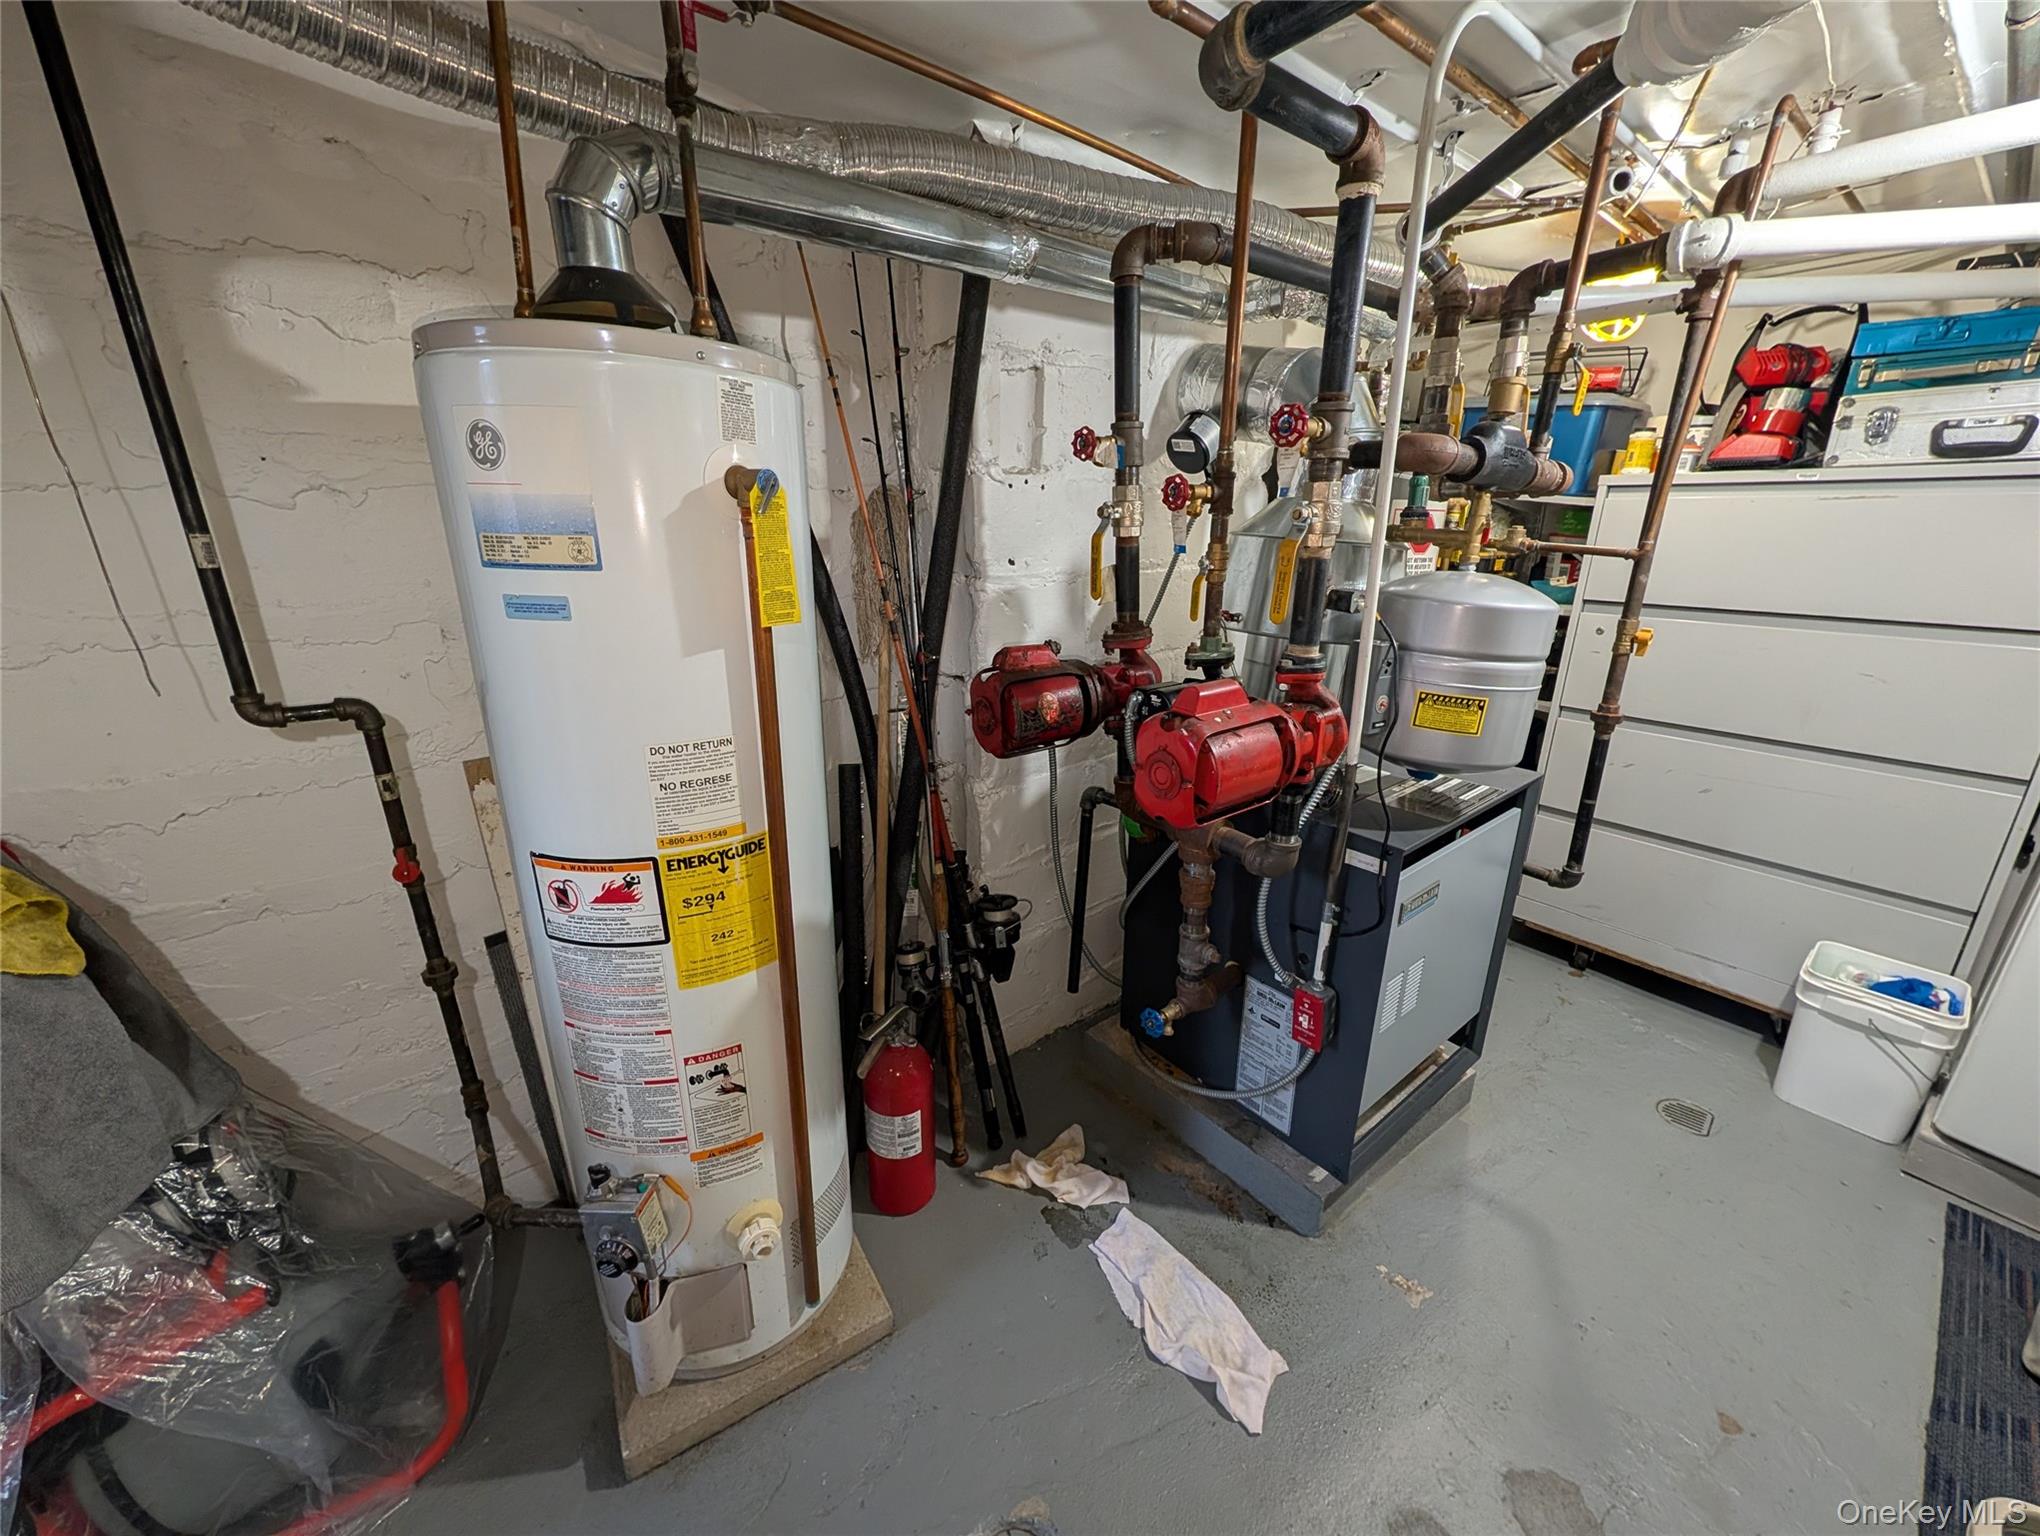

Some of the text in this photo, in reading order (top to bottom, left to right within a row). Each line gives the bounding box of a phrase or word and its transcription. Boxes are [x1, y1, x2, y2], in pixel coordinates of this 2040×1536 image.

[1435, 699, 1468, 709] WARNING
[649, 737, 733, 756] DO NOT RETURN
[659, 782, 677, 792] NO
[680, 773, 733, 790] REGRESE
[660, 829, 728, 846] 1-800-431-1549
[666, 838, 766, 873] ENERGYGUIDE
[570, 862, 614, 872] WARNING
[682, 890, 726, 910] $294
[710, 929, 734, 942] 242
[698, 1047, 740, 1063] DANGER
